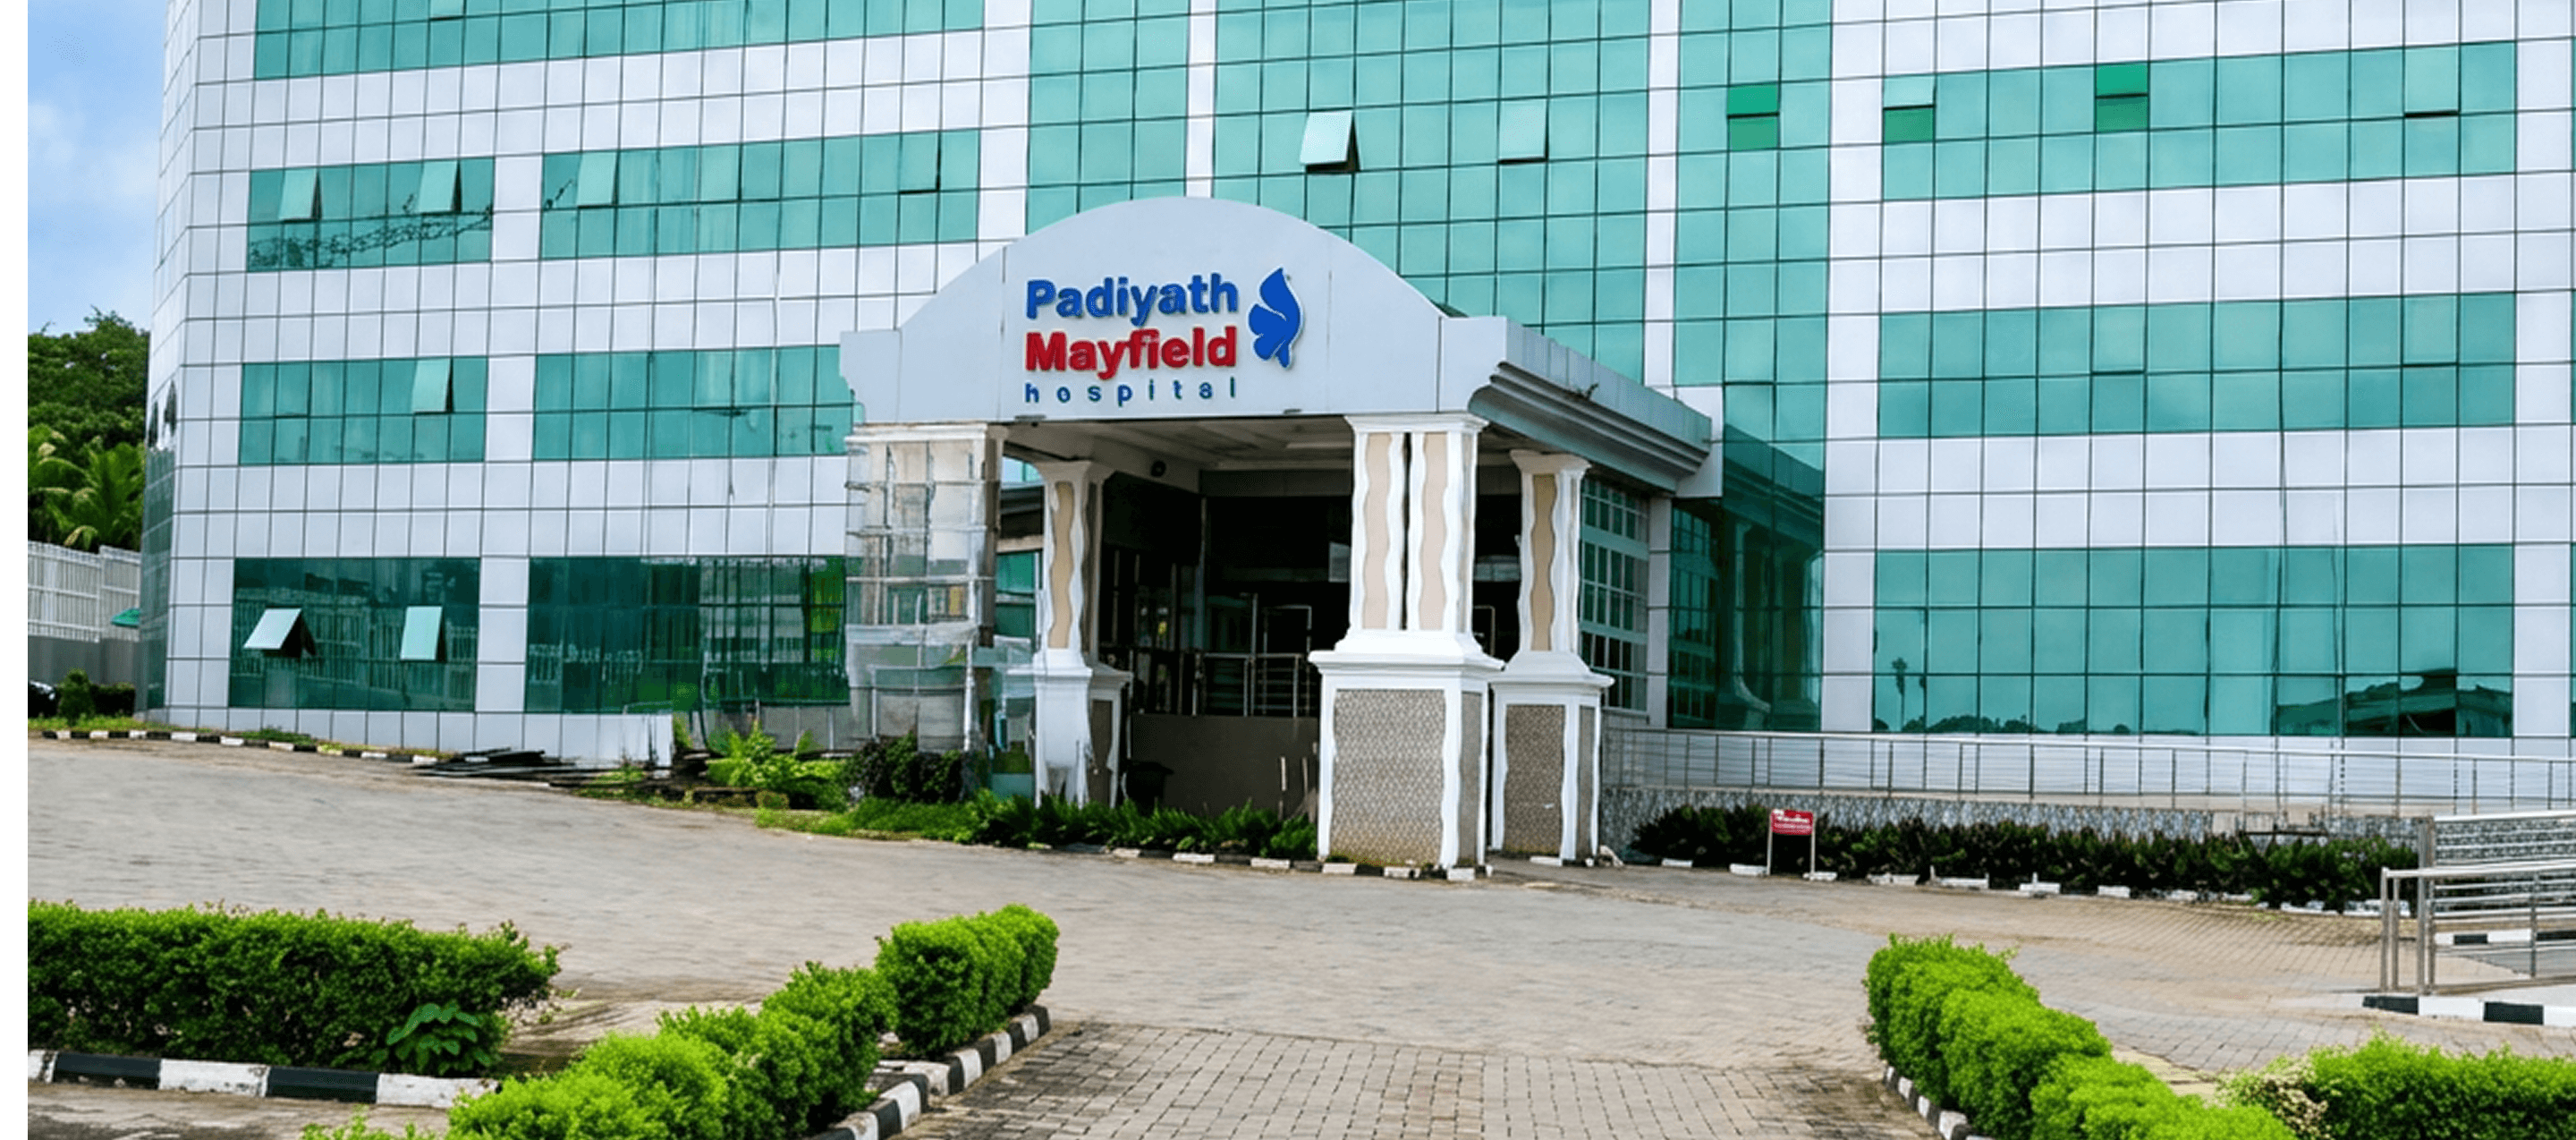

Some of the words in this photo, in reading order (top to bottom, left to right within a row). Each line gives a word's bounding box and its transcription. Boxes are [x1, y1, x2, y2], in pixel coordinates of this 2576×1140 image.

[1026, 273, 1239, 327] Padiyath
[1025, 326, 1238, 379] Mayfield
[1025, 377, 1235, 407] hospital
